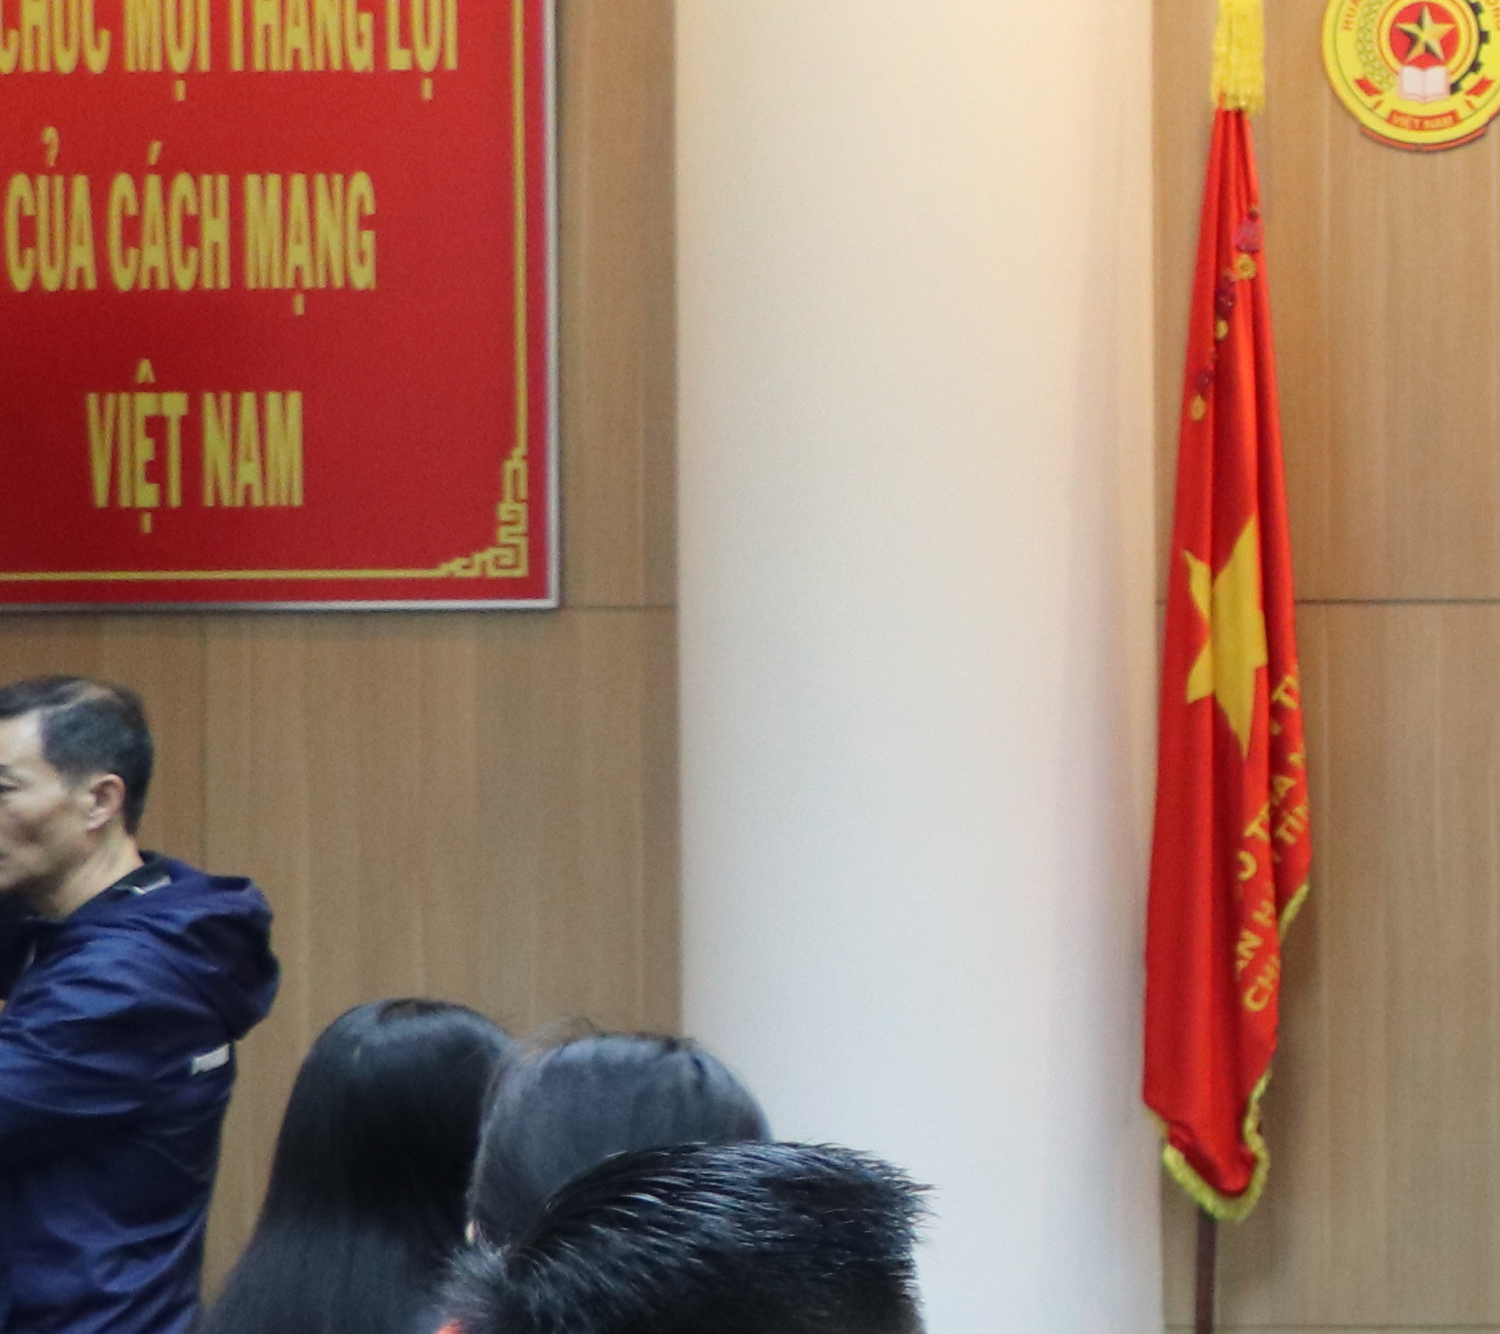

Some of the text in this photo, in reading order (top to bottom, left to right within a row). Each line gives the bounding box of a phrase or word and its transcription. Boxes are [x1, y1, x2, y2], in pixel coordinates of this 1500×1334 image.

[4, 126, 376, 315] CỦA CÁCH MẠNG
[87, 358, 303, 533] VIỆT NAM
